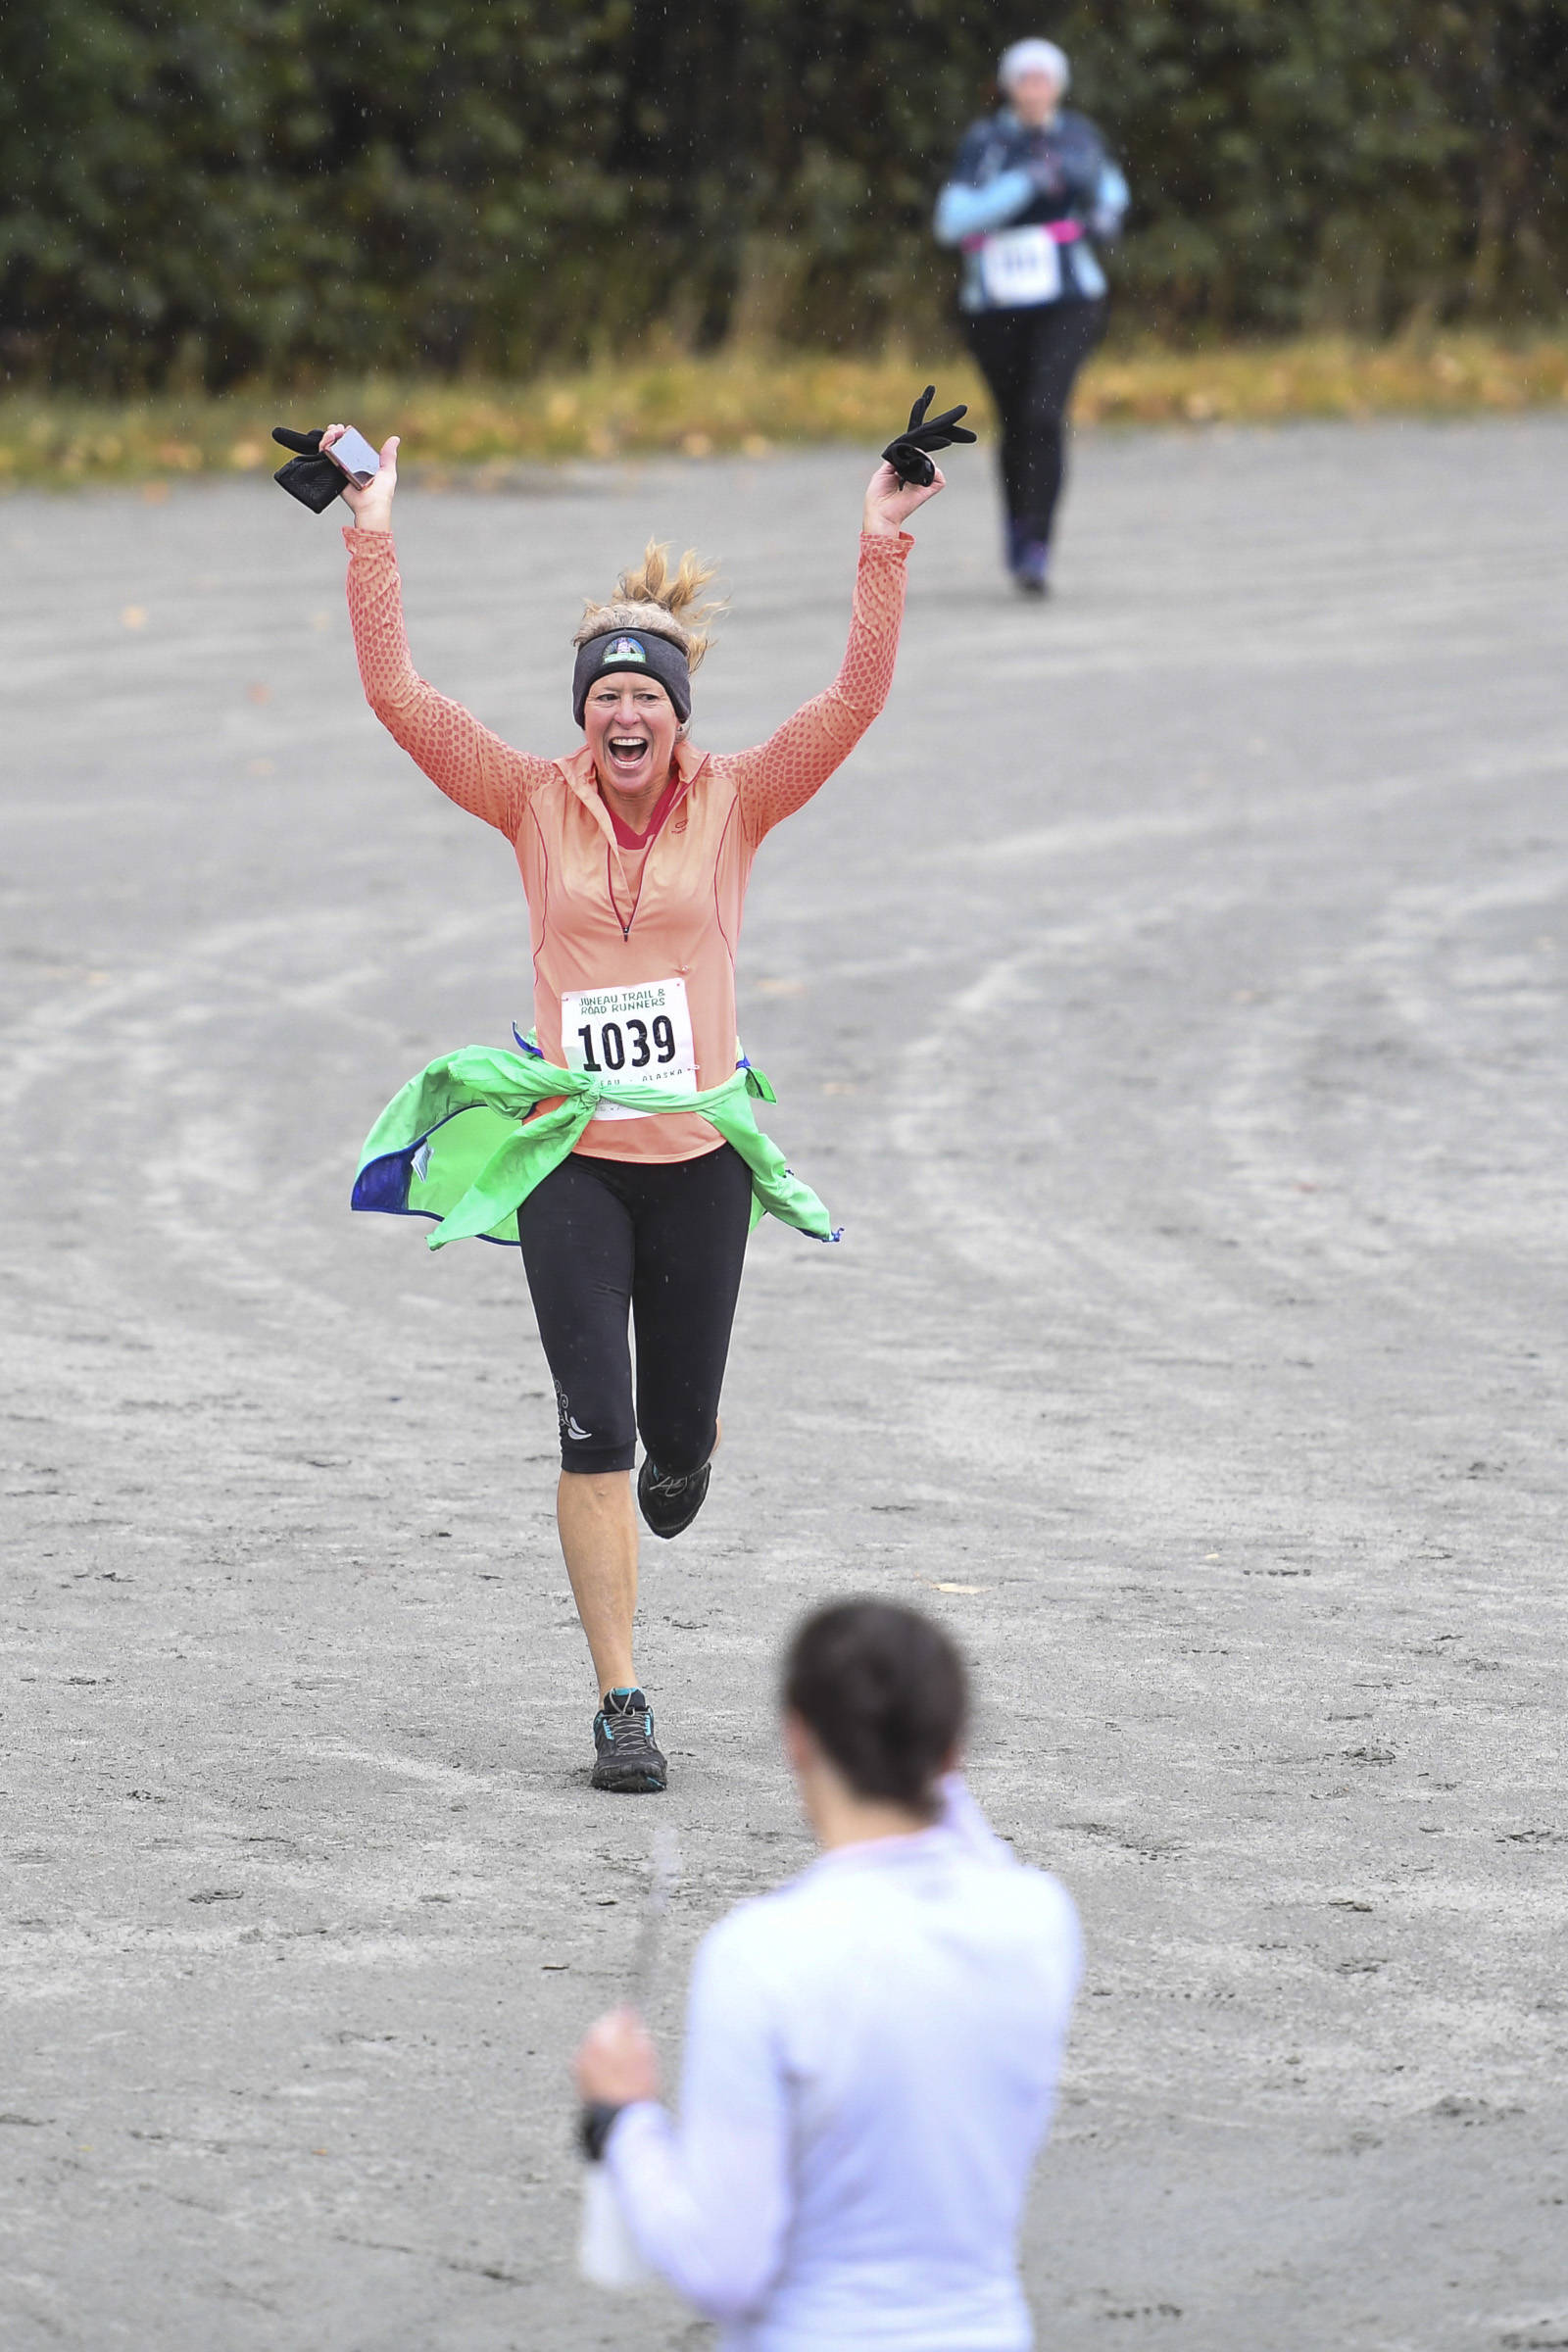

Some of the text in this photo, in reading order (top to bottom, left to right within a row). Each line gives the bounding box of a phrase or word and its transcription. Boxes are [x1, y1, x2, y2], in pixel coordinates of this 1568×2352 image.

[579, 988, 665, 1006] JUNEAU TRAIL &
[580, 998, 665, 1015] ROAD RUNNERS
[578, 1015, 676, 1072] 1039
[642, 1068, 683, 1082] ALASKA
